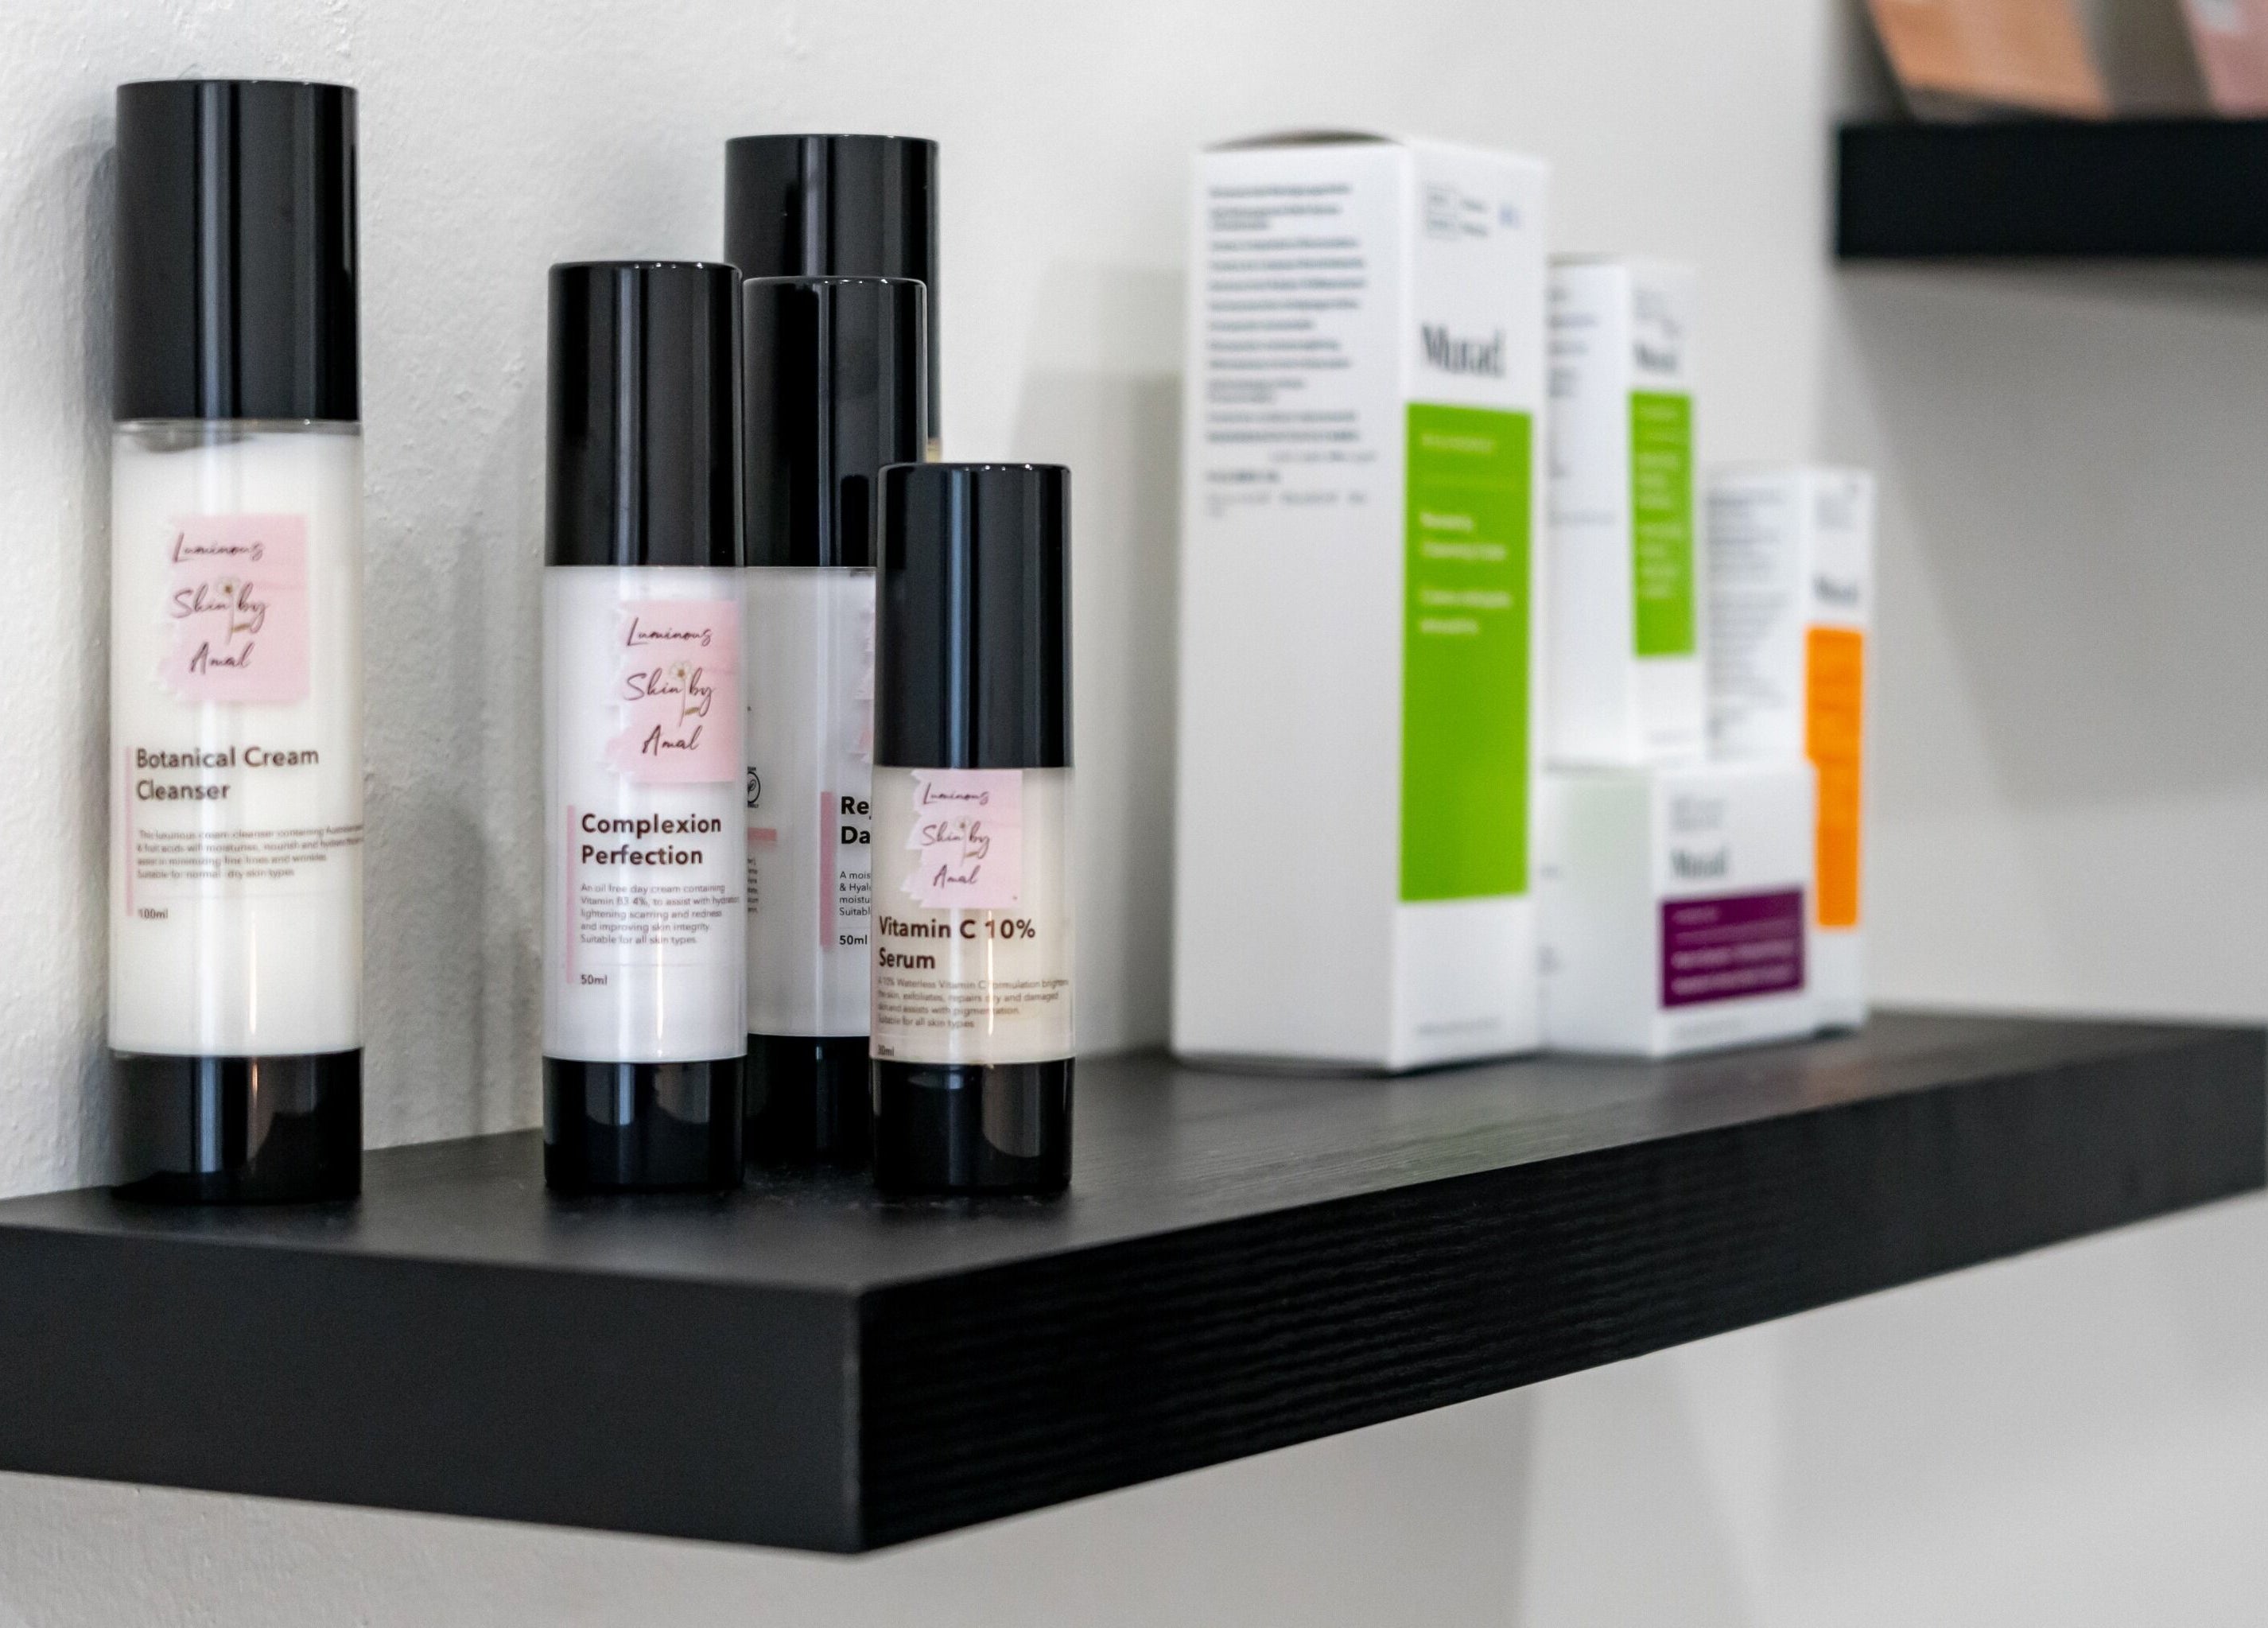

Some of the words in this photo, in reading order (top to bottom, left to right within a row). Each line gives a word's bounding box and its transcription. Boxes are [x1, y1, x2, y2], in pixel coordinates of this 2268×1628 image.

[173, 531, 264, 563] Luminous
[171, 583, 231, 619] Skin
[237, 581, 270, 634] by
[627, 617, 713, 647] Luminous
[188, 641, 256, 674] Amal
[623, 667, 682, 701] Skin
[689, 667, 716, 717] by
[642, 724, 703, 756] Amal
[136, 746, 236, 768] Botanical
[243, 745, 320, 767] Cream
[136, 779, 231, 801] Cleanser
[922, 782, 990, 805] Luminous
[841, 795, 872, 820] Re
[581, 813, 722, 839] Complexion
[841, 826, 872, 845] Da
[921, 821, 963, 846] Skin
[969, 821, 991, 860] by
[581, 844, 703, 865] Perfection
[932, 864, 981, 888] Amal
[581, 883, 592, 892] An
[595, 884, 606, 892] oil
[608, 883, 627, 892] free
[630, 884, 648, 896] day
[683, 884, 725, 895] containing
[839, 883, 847, 892] &
[581, 896, 614, 905] Vitamin
[653, 897, 663, 906] to
[666, 896, 690, 906] assist
[693, 896, 711, 905] with
[138, 907, 169, 919] 100ml
[581, 908, 627, 920] lightening
[671, 909, 689, 918] and
[692, 909, 722, 918] redness
[581, 922, 596, 931] and
[599, 923, 650, 935] improving
[652, 921, 671, 931] skin
[879, 915, 952, 938] Vitamin
[959, 919, 977, 939] C
[984, 918, 1036, 939] 10%
[581, 934, 616, 944] Suitable
[619, 934, 633, 944] for
[635, 934, 647, 944] all
[649, 934, 669, 944] skin
[839, 934, 868, 946] 50ml
[879, 947, 936, 969] Serum
[581, 973, 608, 985] 50ml
[988, 977, 1041, 989] ormulation
